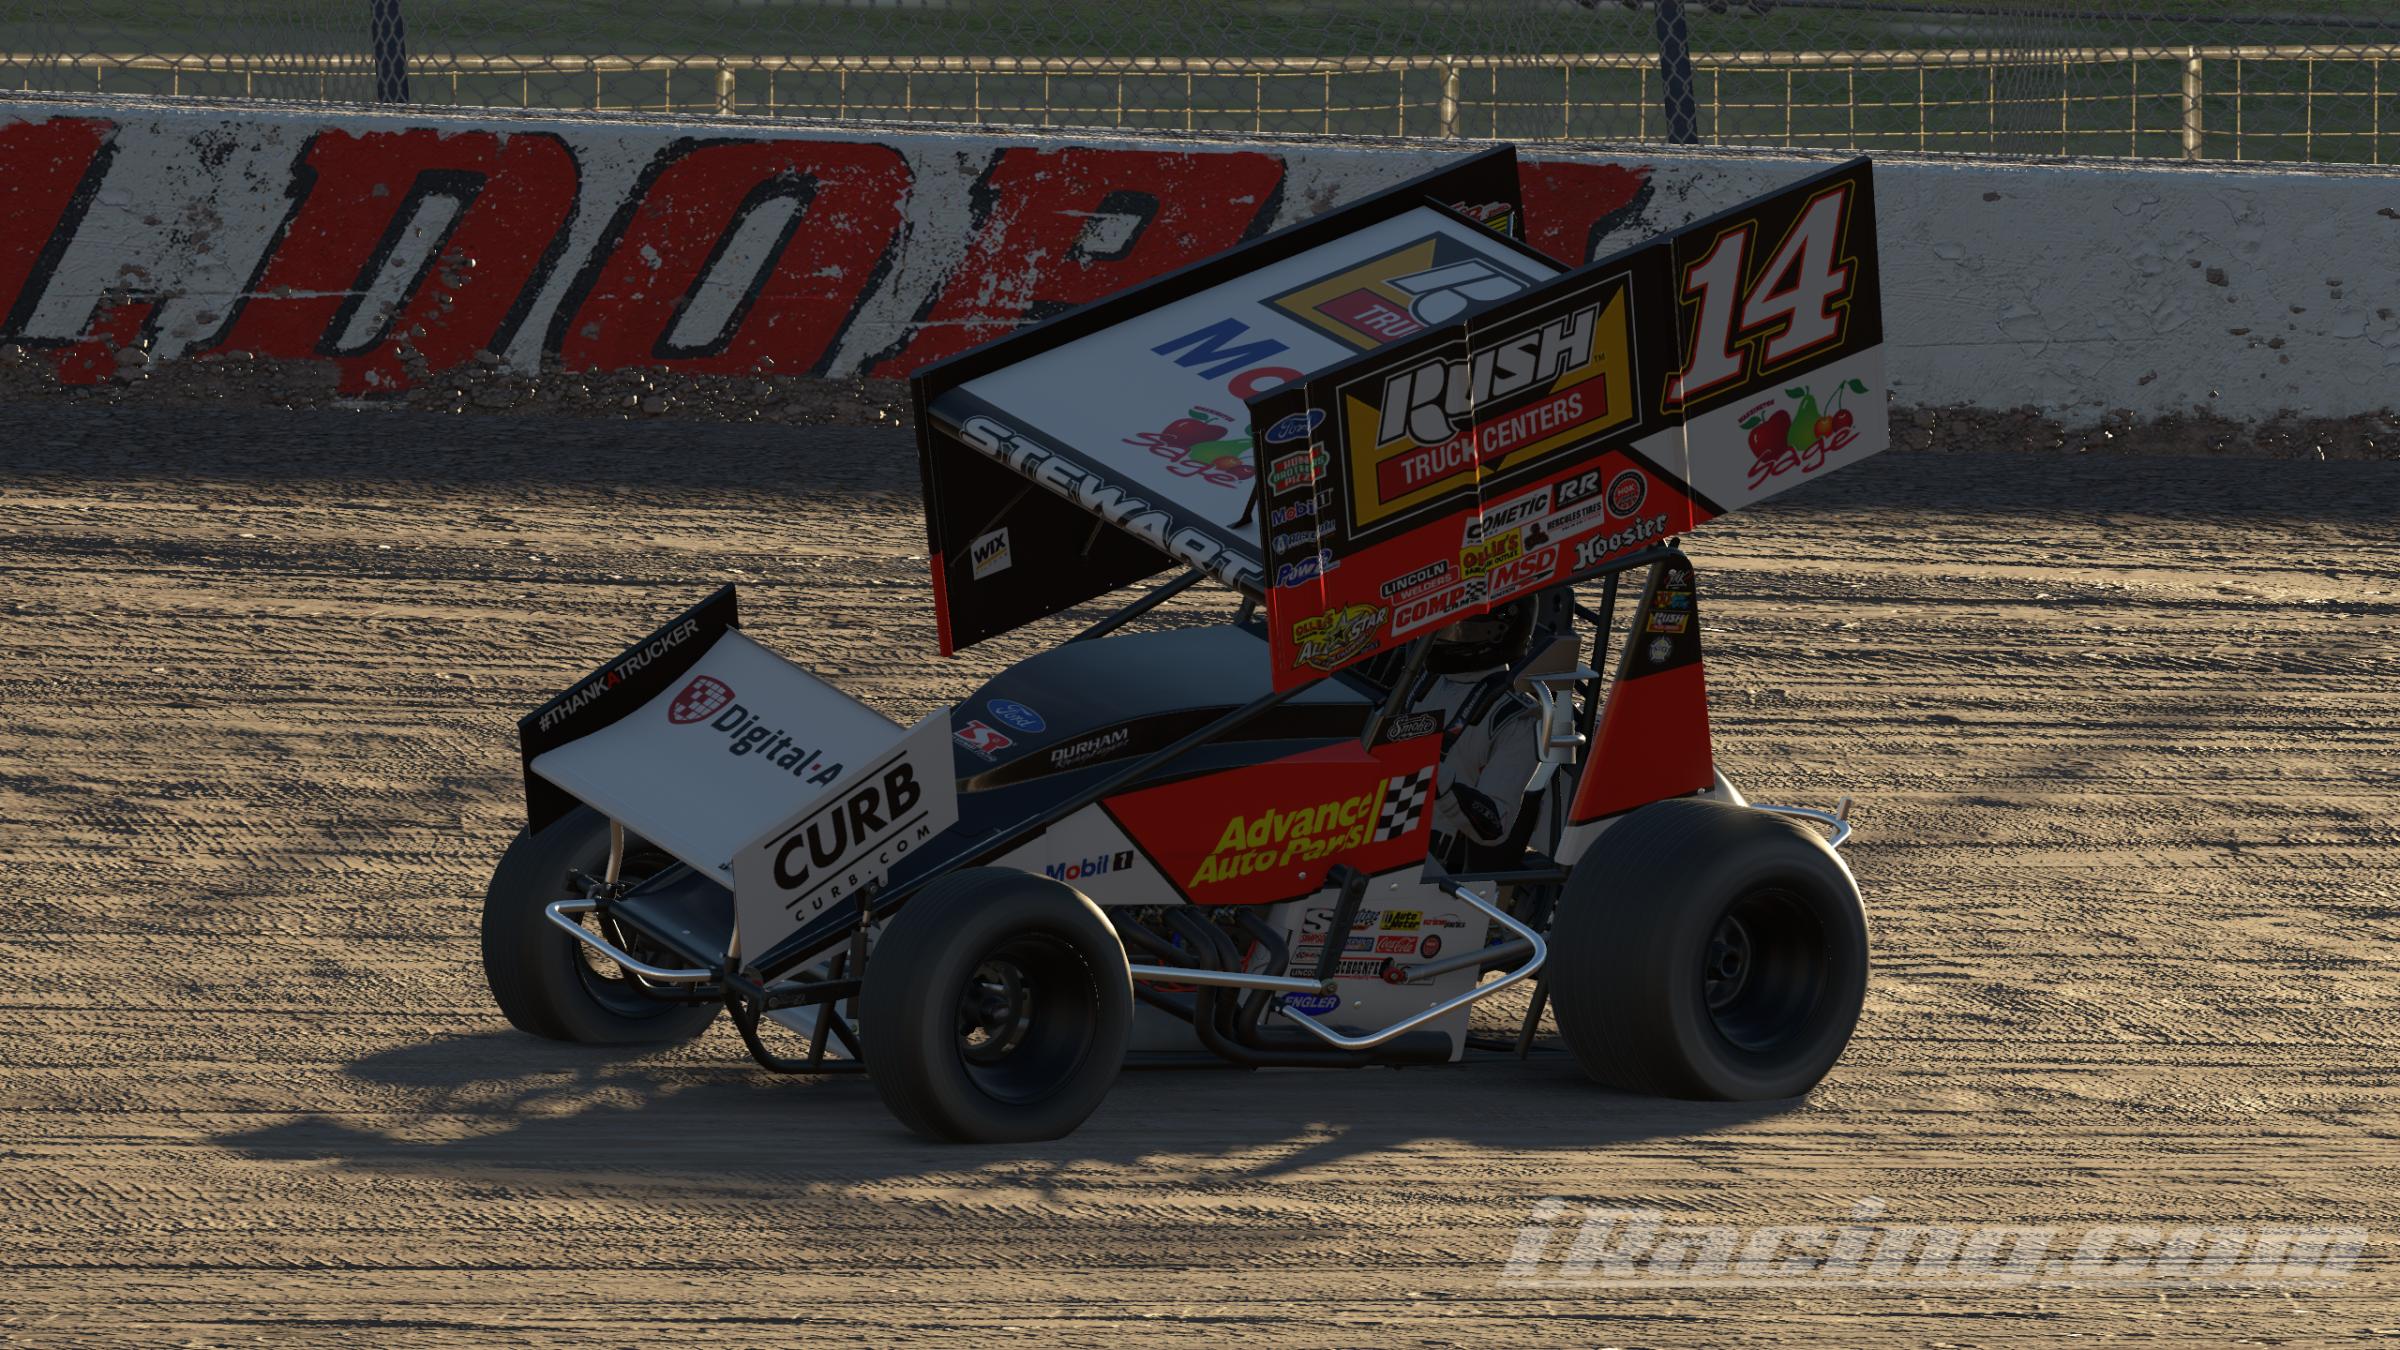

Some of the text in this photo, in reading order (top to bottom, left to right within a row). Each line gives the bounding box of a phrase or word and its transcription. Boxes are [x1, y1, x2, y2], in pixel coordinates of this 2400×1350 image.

[1663, 183, 1853, 408] 14
[1352, 302, 1426, 340] TRU
[1377, 302, 1600, 448] RUSH
[1401, 391, 1584, 486] TRUCK CENTERS
[959, 414, 1265, 593] STEWART
[1467, 493, 1549, 540] COMETIC
[1546, 509, 1582, 531] HERCULES
[973, 532, 1006, 565] WIX
[1572, 514, 1668, 573] Hoosier
[1384, 562, 1447, 596] LINCOLN
[1400, 573, 1453, 601] WELDERS
[1494, 547, 1557, 591] MSD
[1350, 607, 1387, 641] STAR
[1396, 586, 1465, 628] COMP
[538, 617, 701, 734] #THANKATRUCKER
[995, 704, 1038, 727] Ford
[1390, 717, 1433, 739] Smoke
[1050, 727, 1129, 763] DURHAM
[773, 762, 921, 891] CURB
[1212, 790, 1374, 856] Advance
[795, 824, 931, 922] CURB.COM
[1045, 854, 1110, 881] Mobil
[1188, 848, 1277, 889] Auto
[1391, 919, 1421, 930] Meter
[1394, 911, 1418, 921] Auto
[1291, 967, 1316, 977] LINCO
[1334, 960, 1382, 976] SCHOENFE
[1285, 995, 1337, 1009] ENGLER
